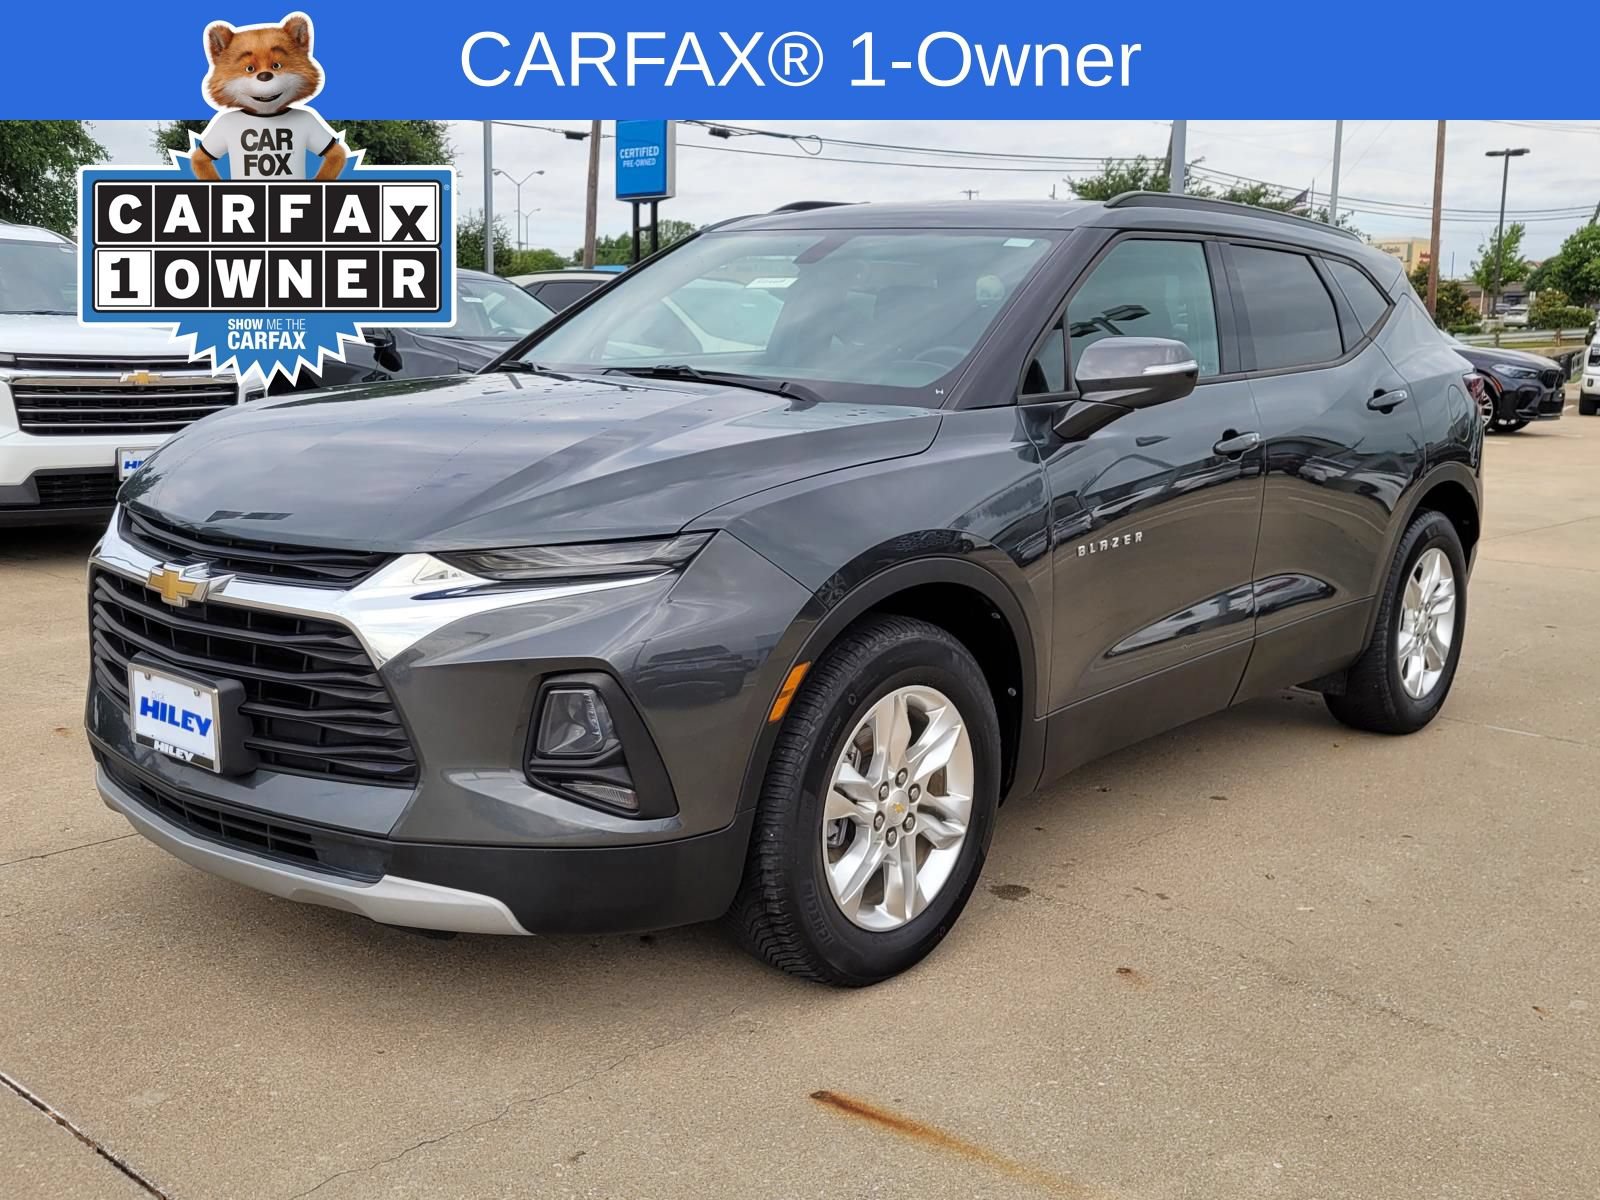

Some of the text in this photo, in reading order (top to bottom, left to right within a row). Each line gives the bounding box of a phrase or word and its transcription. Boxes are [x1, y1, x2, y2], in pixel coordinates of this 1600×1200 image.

[619, 145, 660, 159] CERTIFIED
[623, 158, 656, 167] PRE-OWNED
[1077, 531, 1143, 557] BLAZER
[140, 696, 212, 737] HILEY
[153, 740, 194, 762] HILEY
